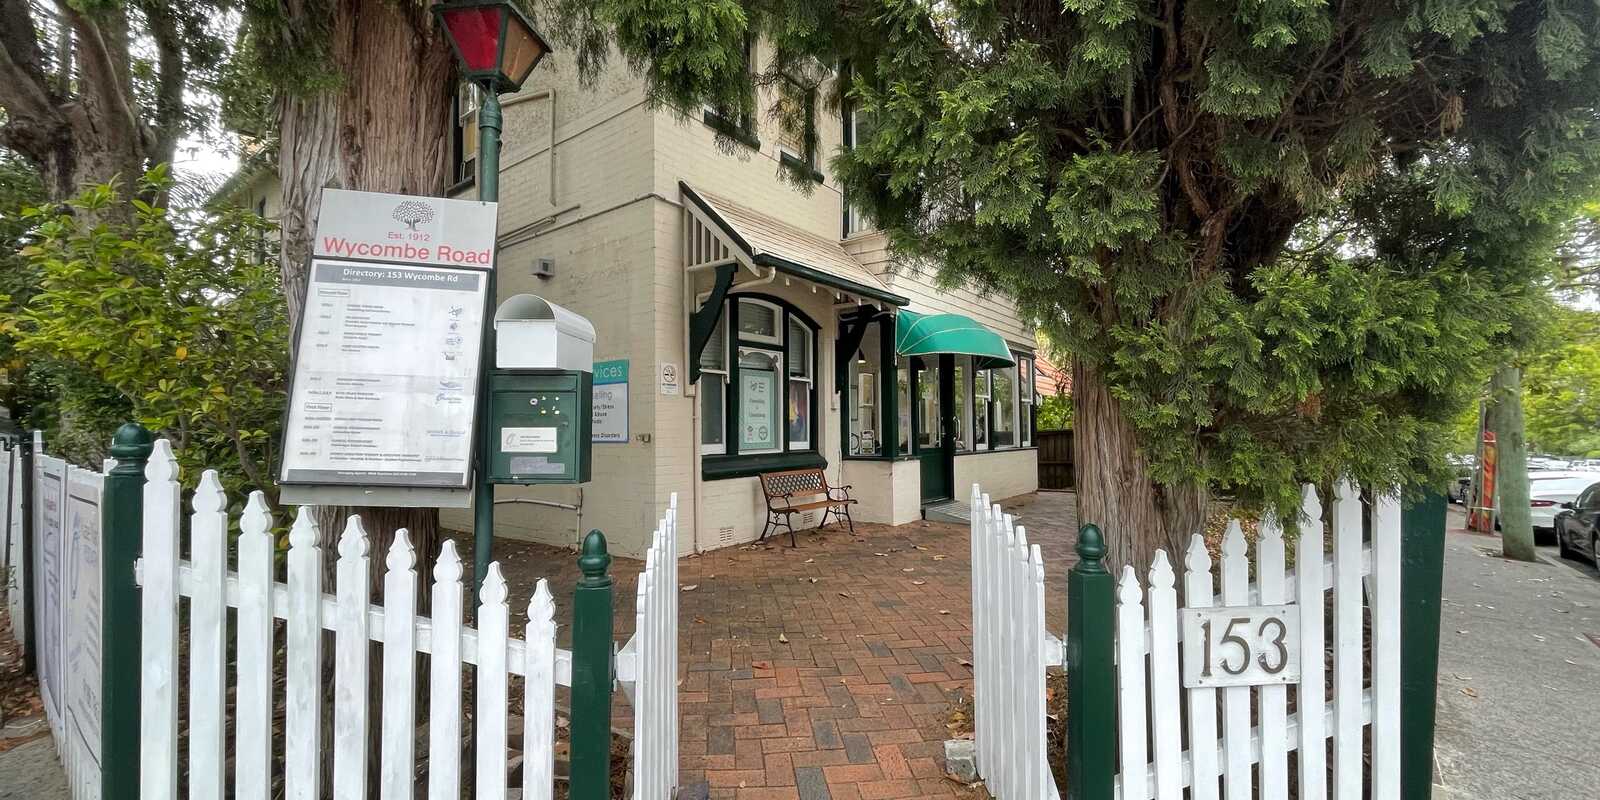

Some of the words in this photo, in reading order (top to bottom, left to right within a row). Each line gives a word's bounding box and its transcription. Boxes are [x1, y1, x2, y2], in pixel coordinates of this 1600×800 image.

[387, 231, 404, 240] Est.
[408, 233, 431, 242] 1912
[323, 236, 430, 261] Wycombe
[437, 245, 491, 265] Road
[343, 268, 385, 281] Directory:
[387, 271, 403, 279] 153
[404, 271, 446, 284] Wycombe
[447, 273, 459, 283] Rd
[594, 366, 623, 378] vices
[1201, 617, 1288, 677] 153
